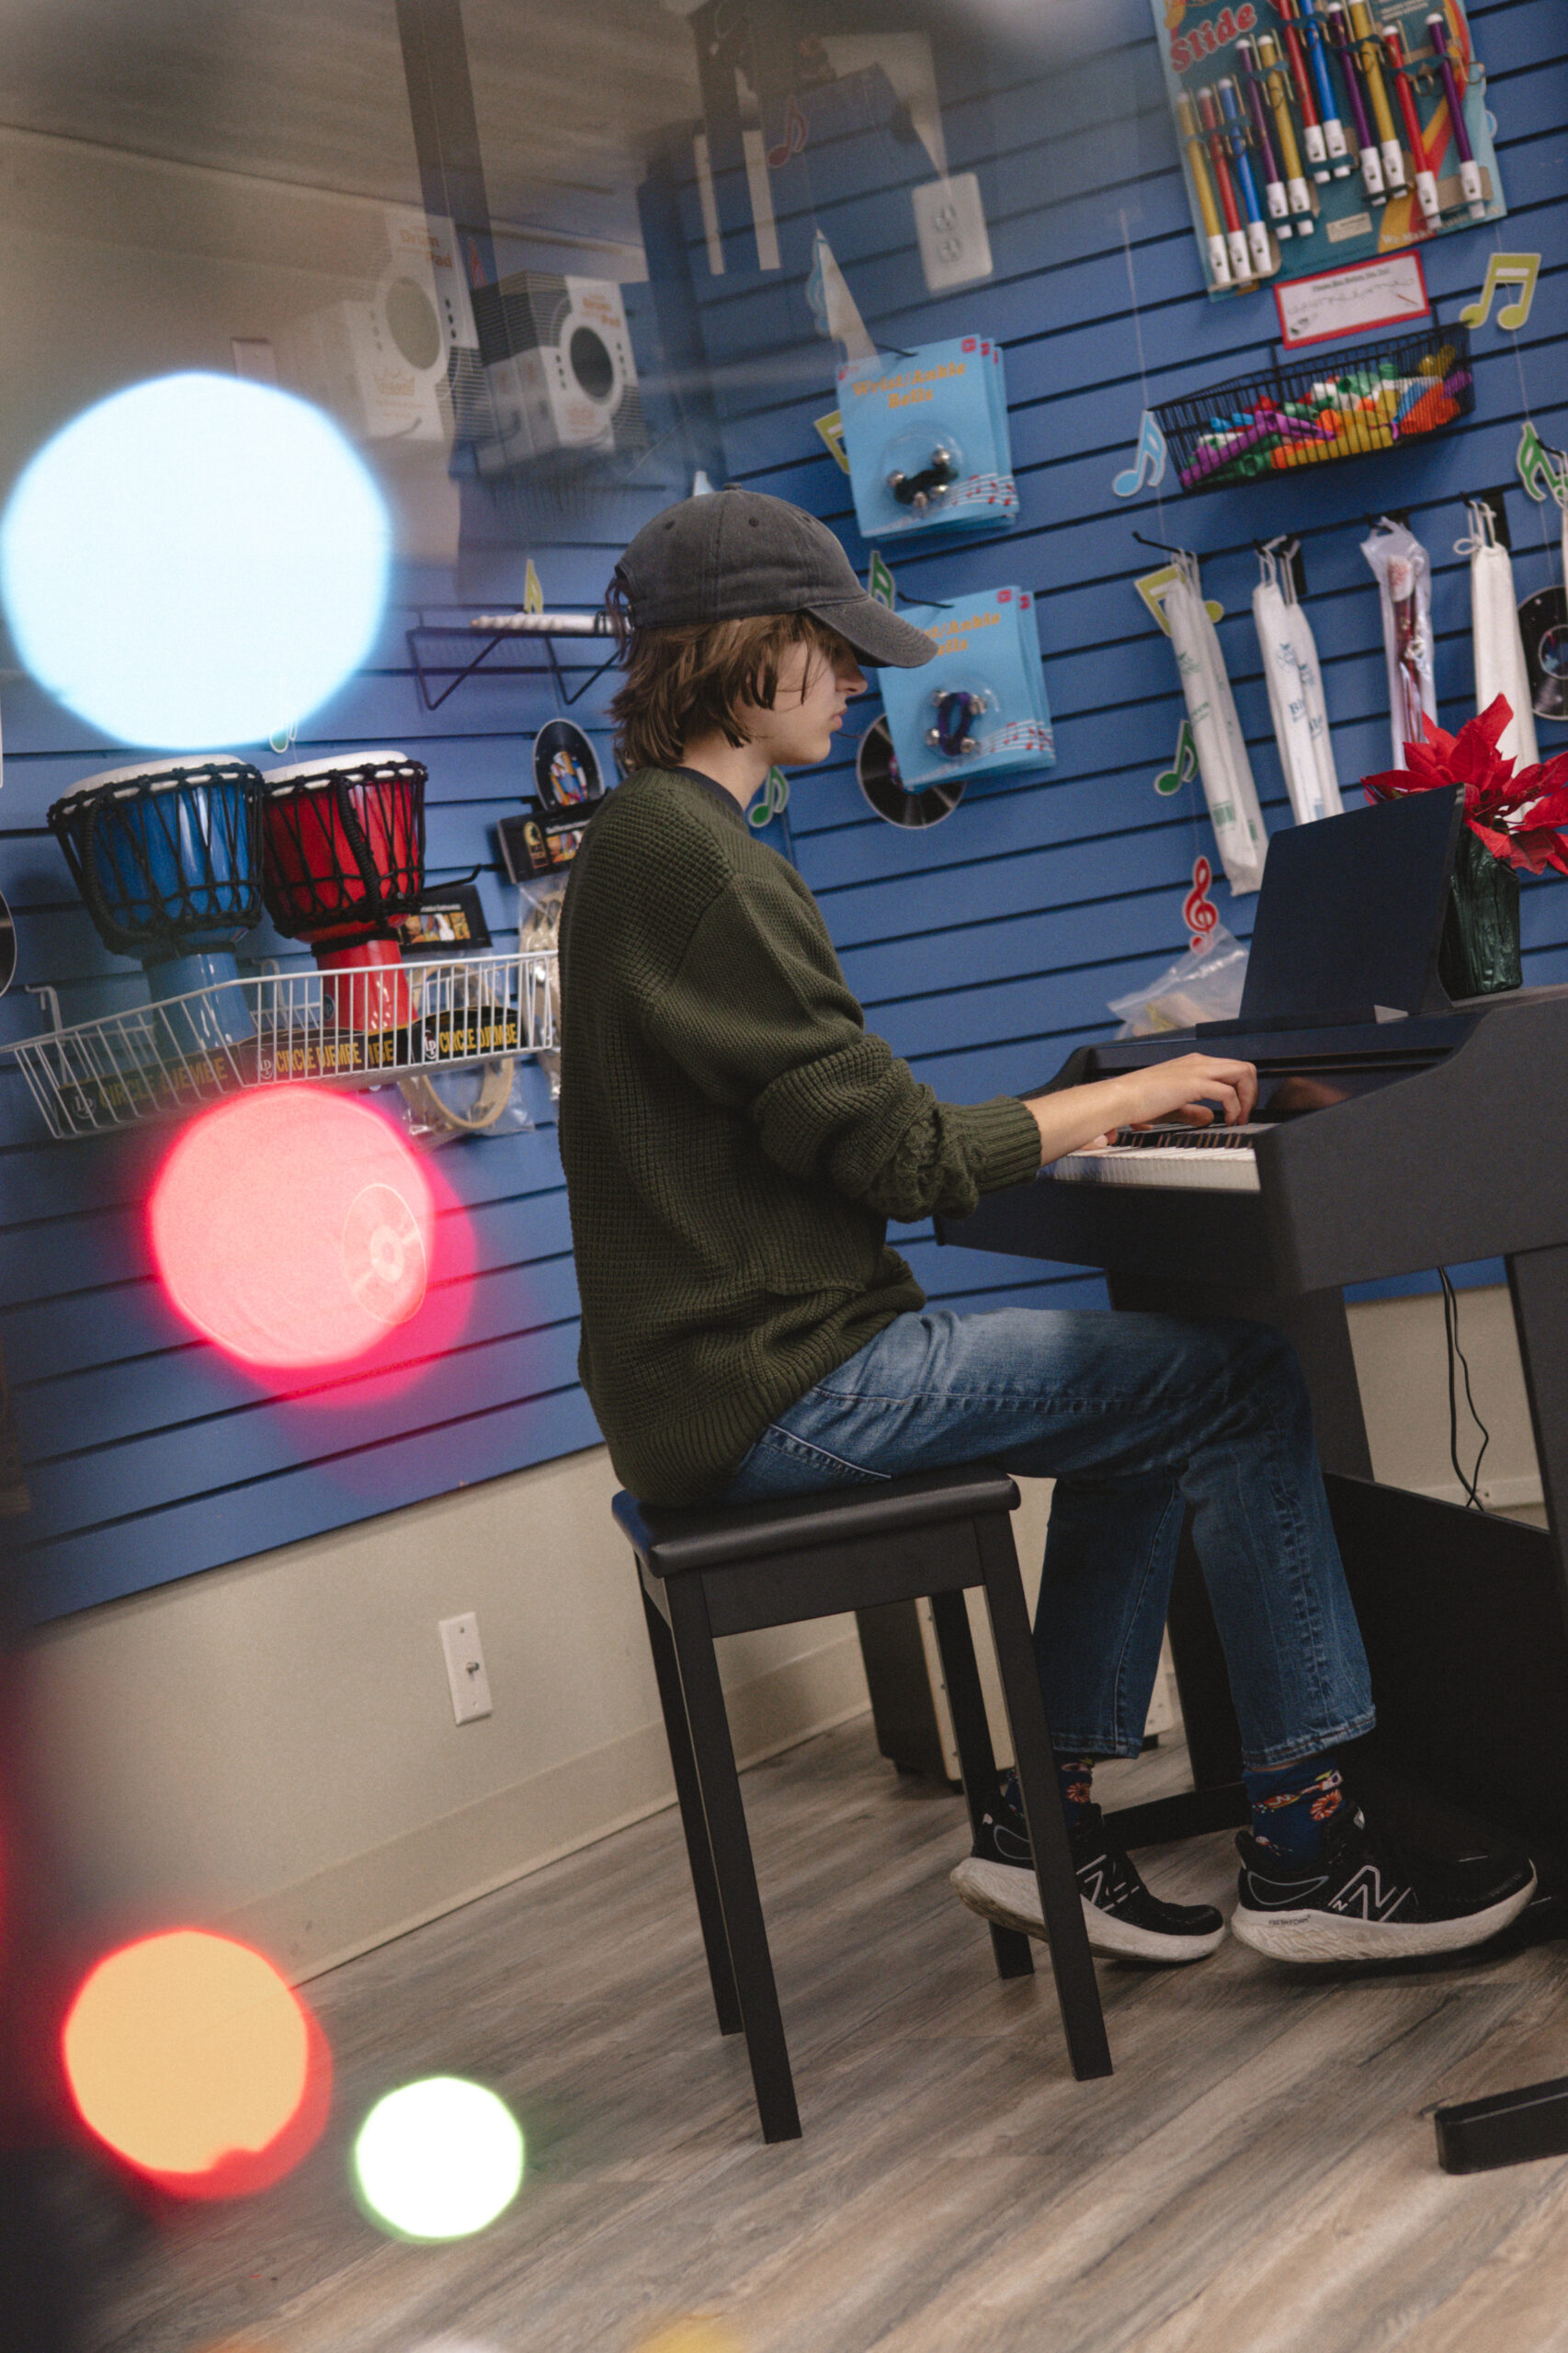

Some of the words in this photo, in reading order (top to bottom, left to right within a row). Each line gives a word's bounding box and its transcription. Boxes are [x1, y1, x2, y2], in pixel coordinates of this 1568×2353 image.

[1170, 3, 1258, 73] Slide
[852, 361, 966, 397] Wrist/Ankle
[888, 387, 934, 410] Bells
[919, 612, 1002, 640] st/Ankle
[937, 637, 969, 657] ells
[275, 1047, 317, 1074] CIRCLE
[315, 1041, 362, 1068] DJEMBE
